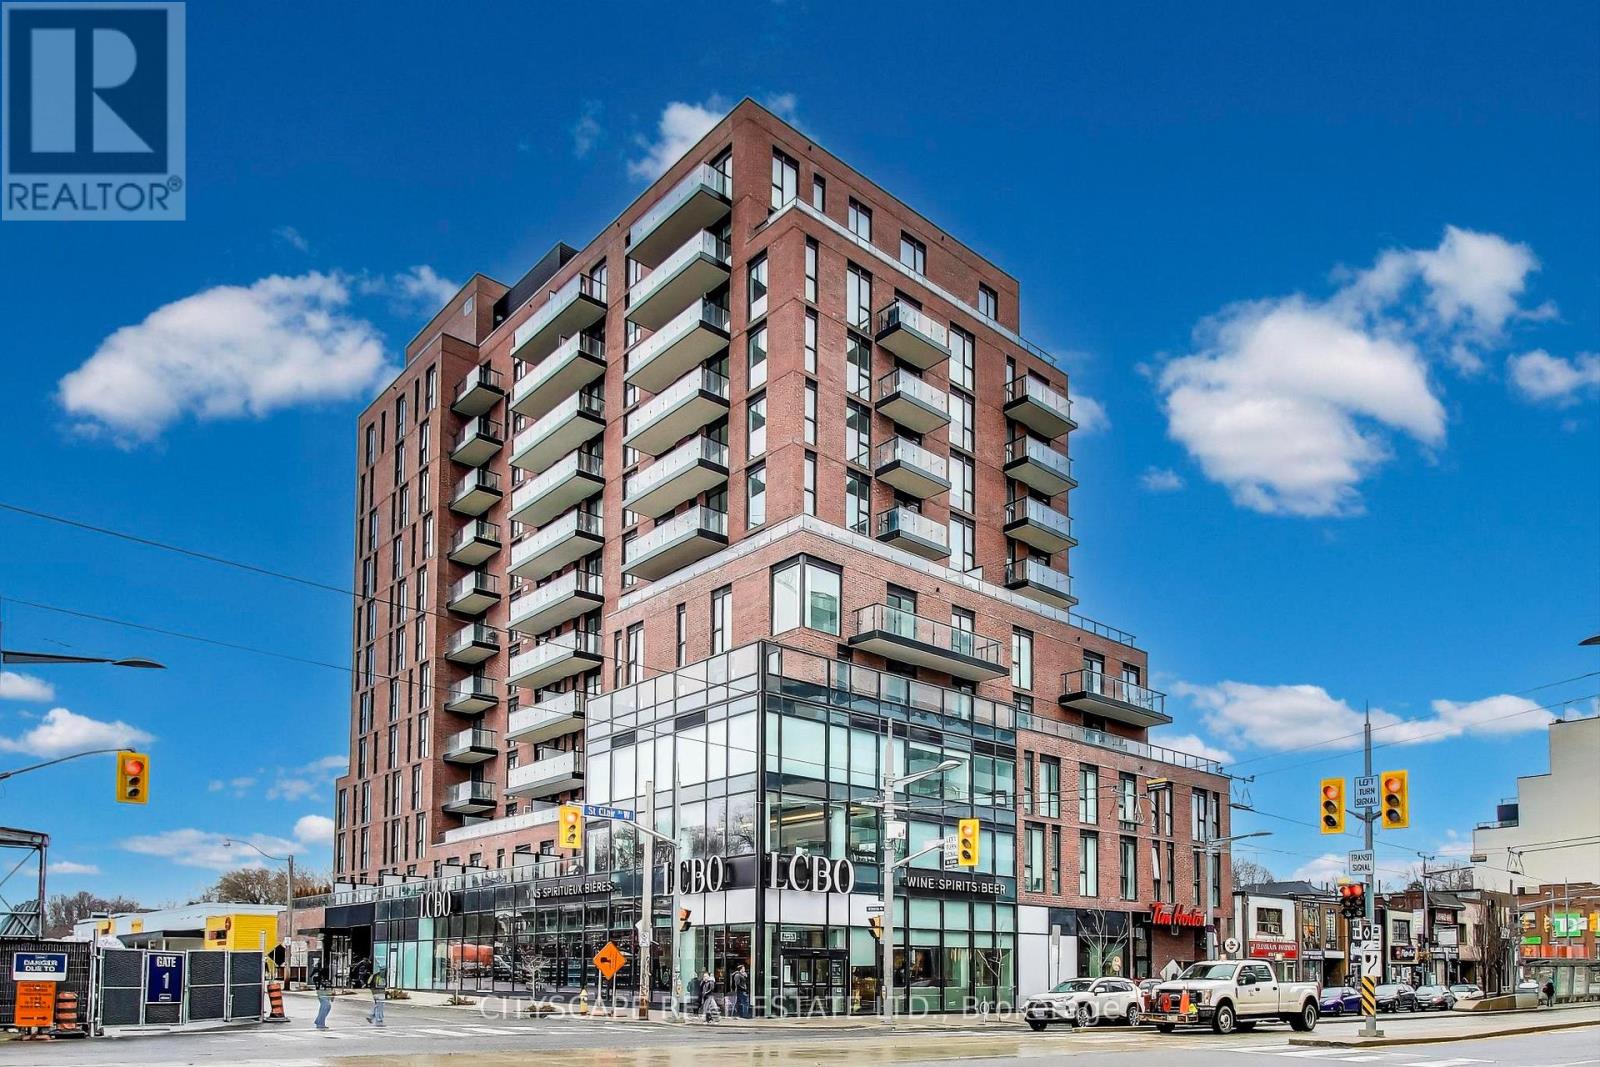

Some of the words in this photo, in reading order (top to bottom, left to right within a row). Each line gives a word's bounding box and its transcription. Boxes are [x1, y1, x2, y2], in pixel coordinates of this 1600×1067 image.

[1359, 787, 1375, 796] TURN
[1356, 798, 1377, 806] SIGNAL
[588, 805, 596, 815] St
[1351, 853, 1373, 862] TRANSIT
[770, 851, 855, 895] LCBO
[1352, 864, 1371, 872] SIGNAL
[663, 855, 723, 896] LCBO
[542, 884, 583, 898] SPIRITUEUX
[906, 876, 935, 889] WINE
[938, 879, 978, 893] SPIRITS
[980, 882, 1006, 895] BEER
[420, 890, 451, 919] LCBO
[1152, 901, 1172, 925] Tim
[156, 956, 177, 968] GATE
[162, 971, 170, 989] 1
